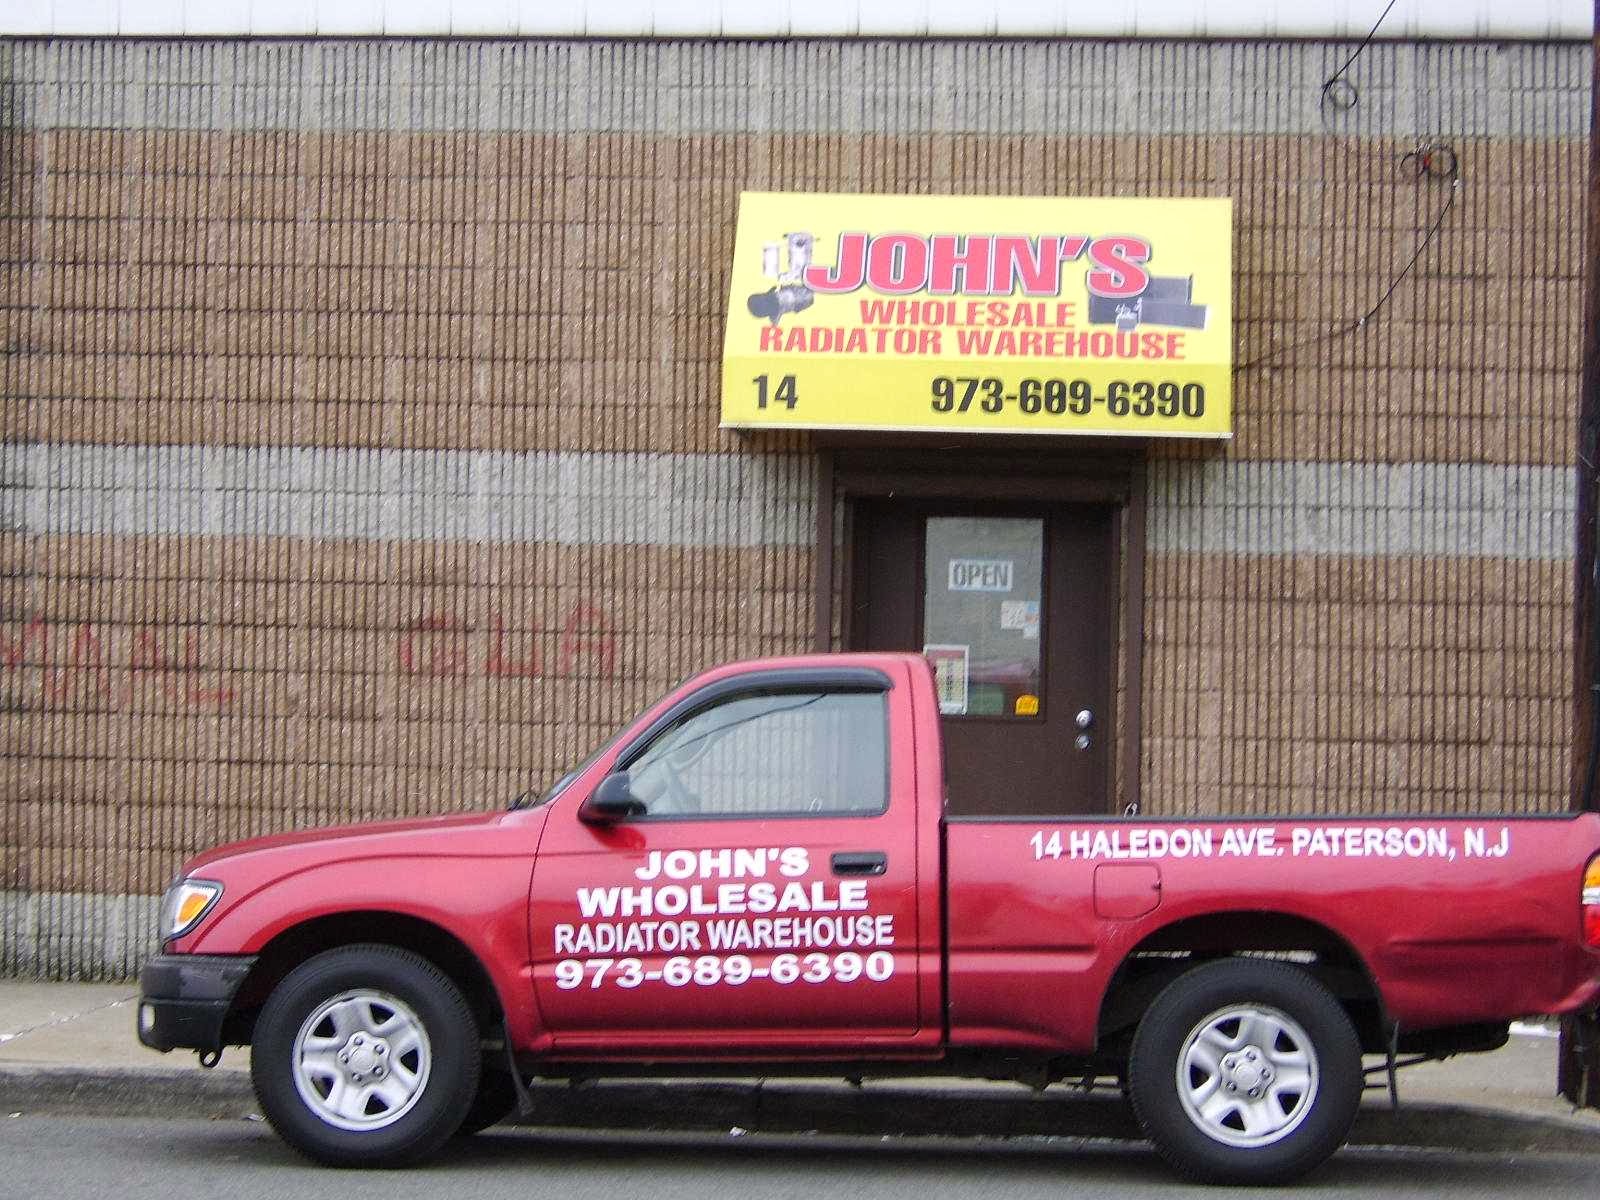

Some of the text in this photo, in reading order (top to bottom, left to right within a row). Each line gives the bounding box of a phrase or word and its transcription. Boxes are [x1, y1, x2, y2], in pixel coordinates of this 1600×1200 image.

[803, 231, 1152, 299] JOHN'S
[859, 299, 1076, 329] WHOLESALE
[759, 325, 1187, 361] RADIATOR WAREHOUSE
[752, 374, 1206, 418] 14 973-689-6390
[952, 564, 1009, 587] OPEN
[635, 847, 810, 880] JOHN'S
[1030, 827, 1510, 863] 14 HALEDON AVE. PATERSON, N.J
[576, 880, 869, 918] WHOLESALE
[554, 914, 895, 954] RADIATOR WAREHOUSE
[554, 951, 895, 990] 973-689-6390
